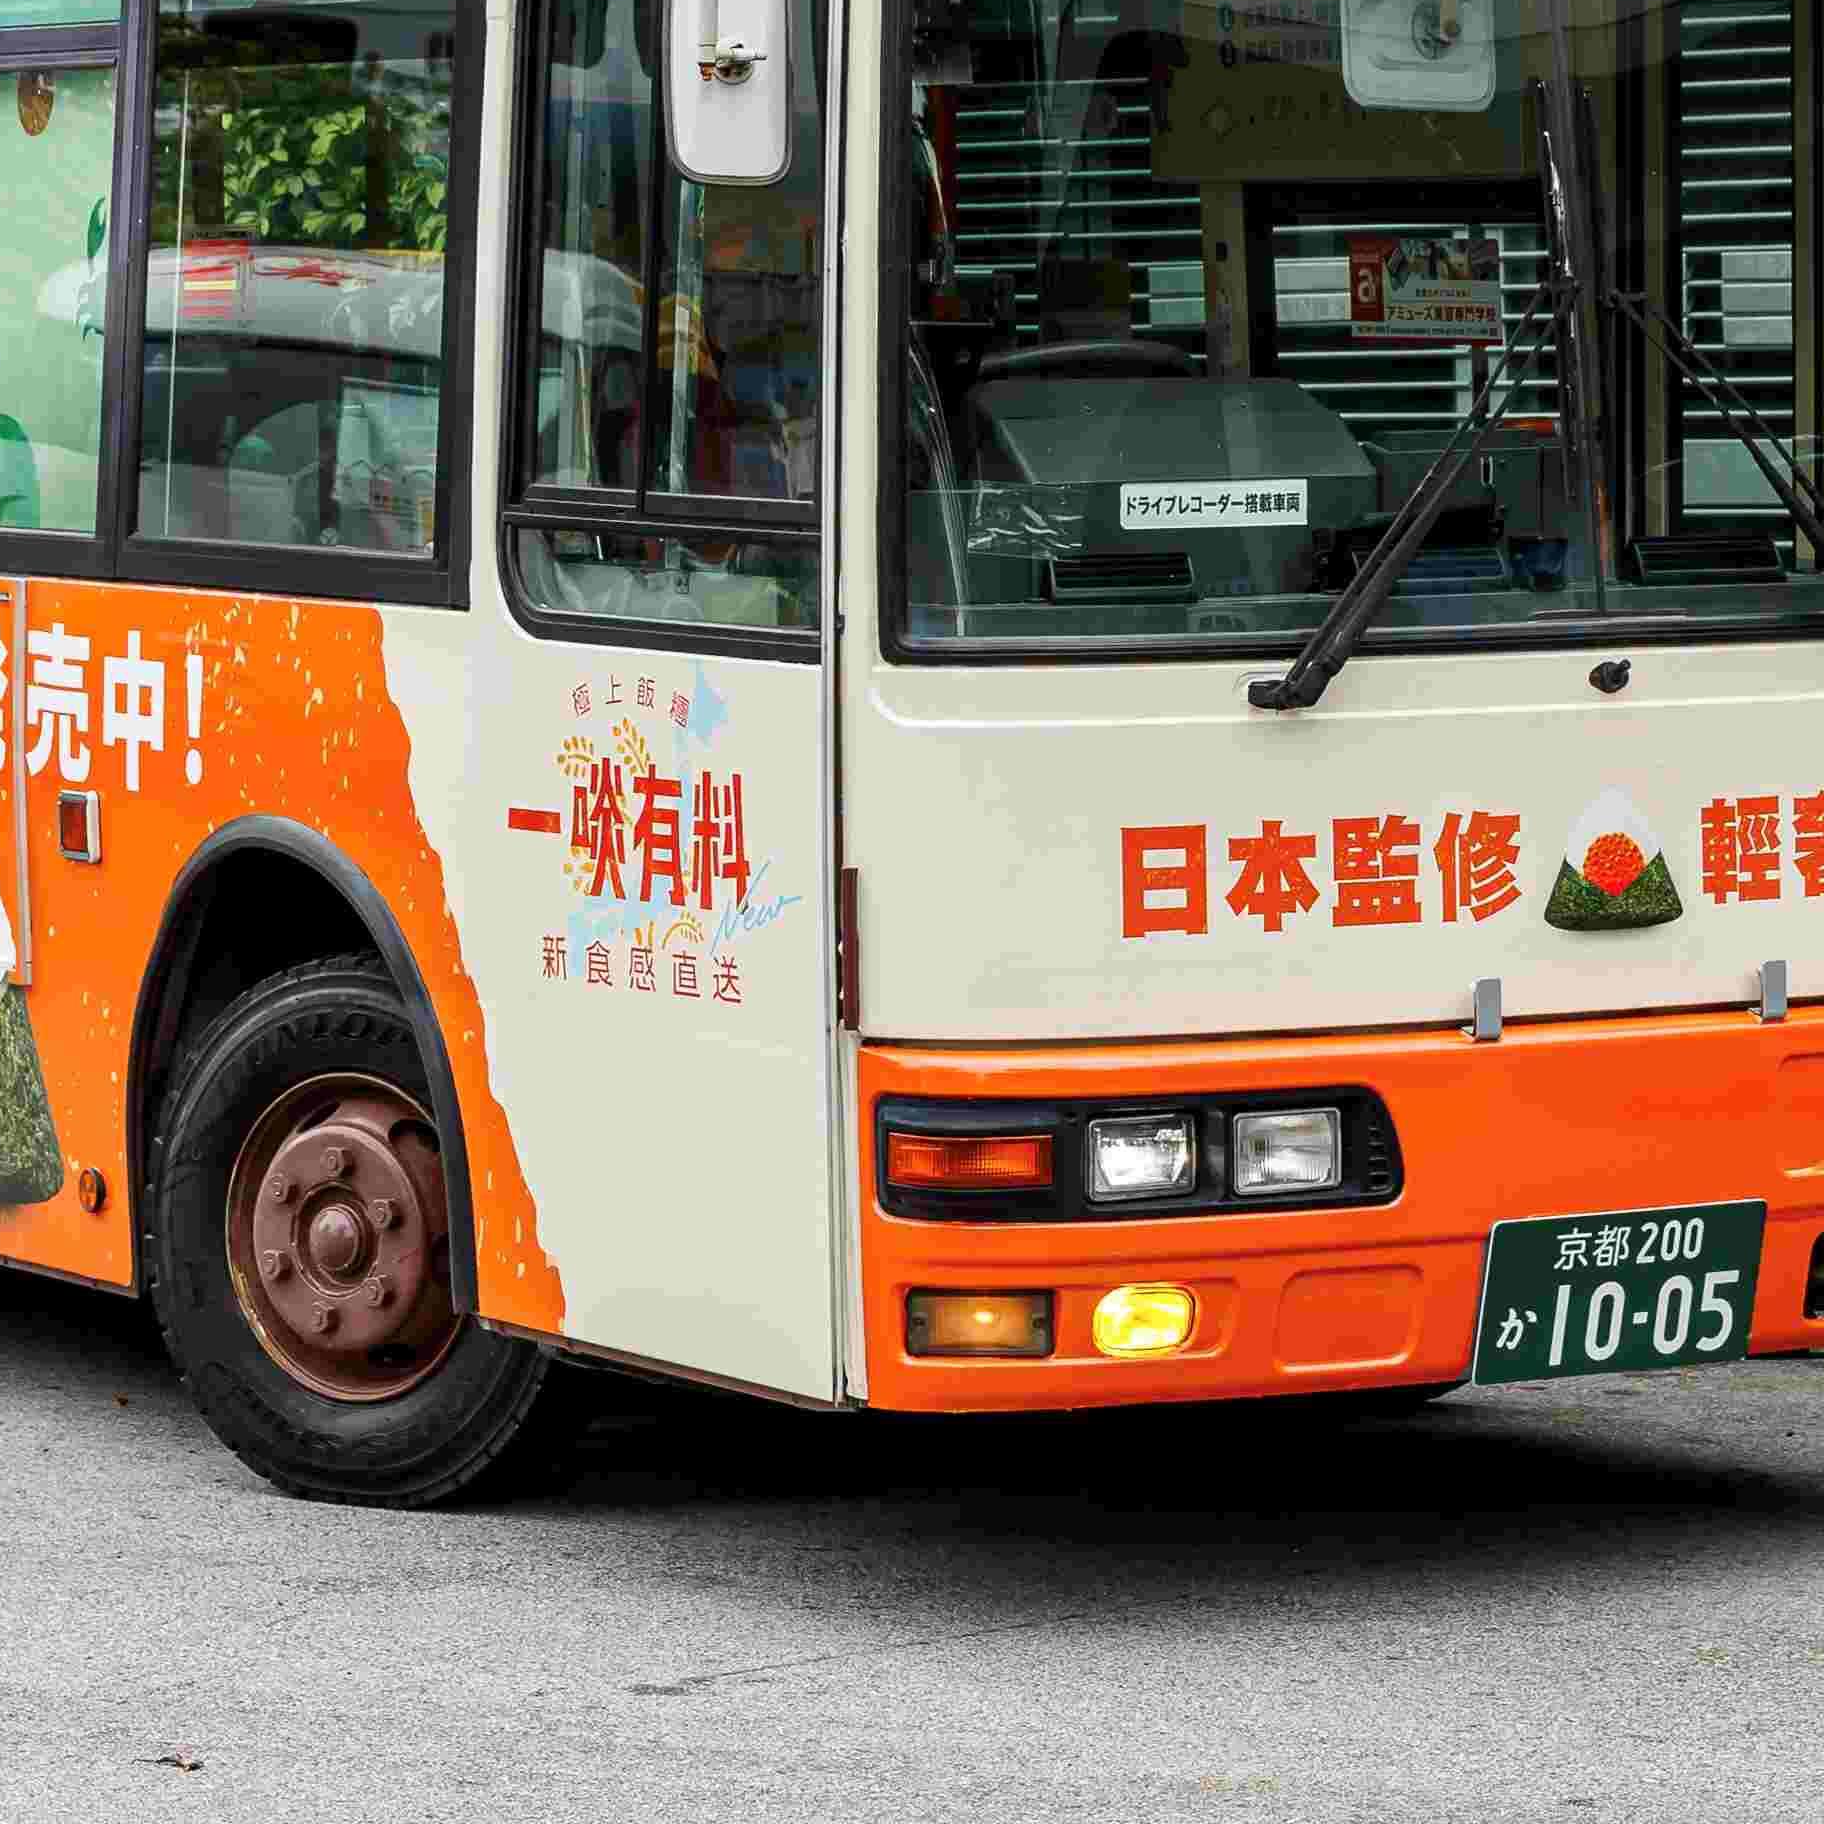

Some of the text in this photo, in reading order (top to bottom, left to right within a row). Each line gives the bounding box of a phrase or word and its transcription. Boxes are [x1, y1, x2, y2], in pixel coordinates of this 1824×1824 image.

[1126, 492, 1301, 516] ドライブレコーダー搭載車両
[507, 757, 752, 913] 一啖有料
[1120, 810, 1523, 939] 日本監修
[541, 935, 744, 1004] 新食感直送
[1554, 1217, 1705, 1272] 京都 200
[1495, 1269, 1741, 1367] か 10-05
